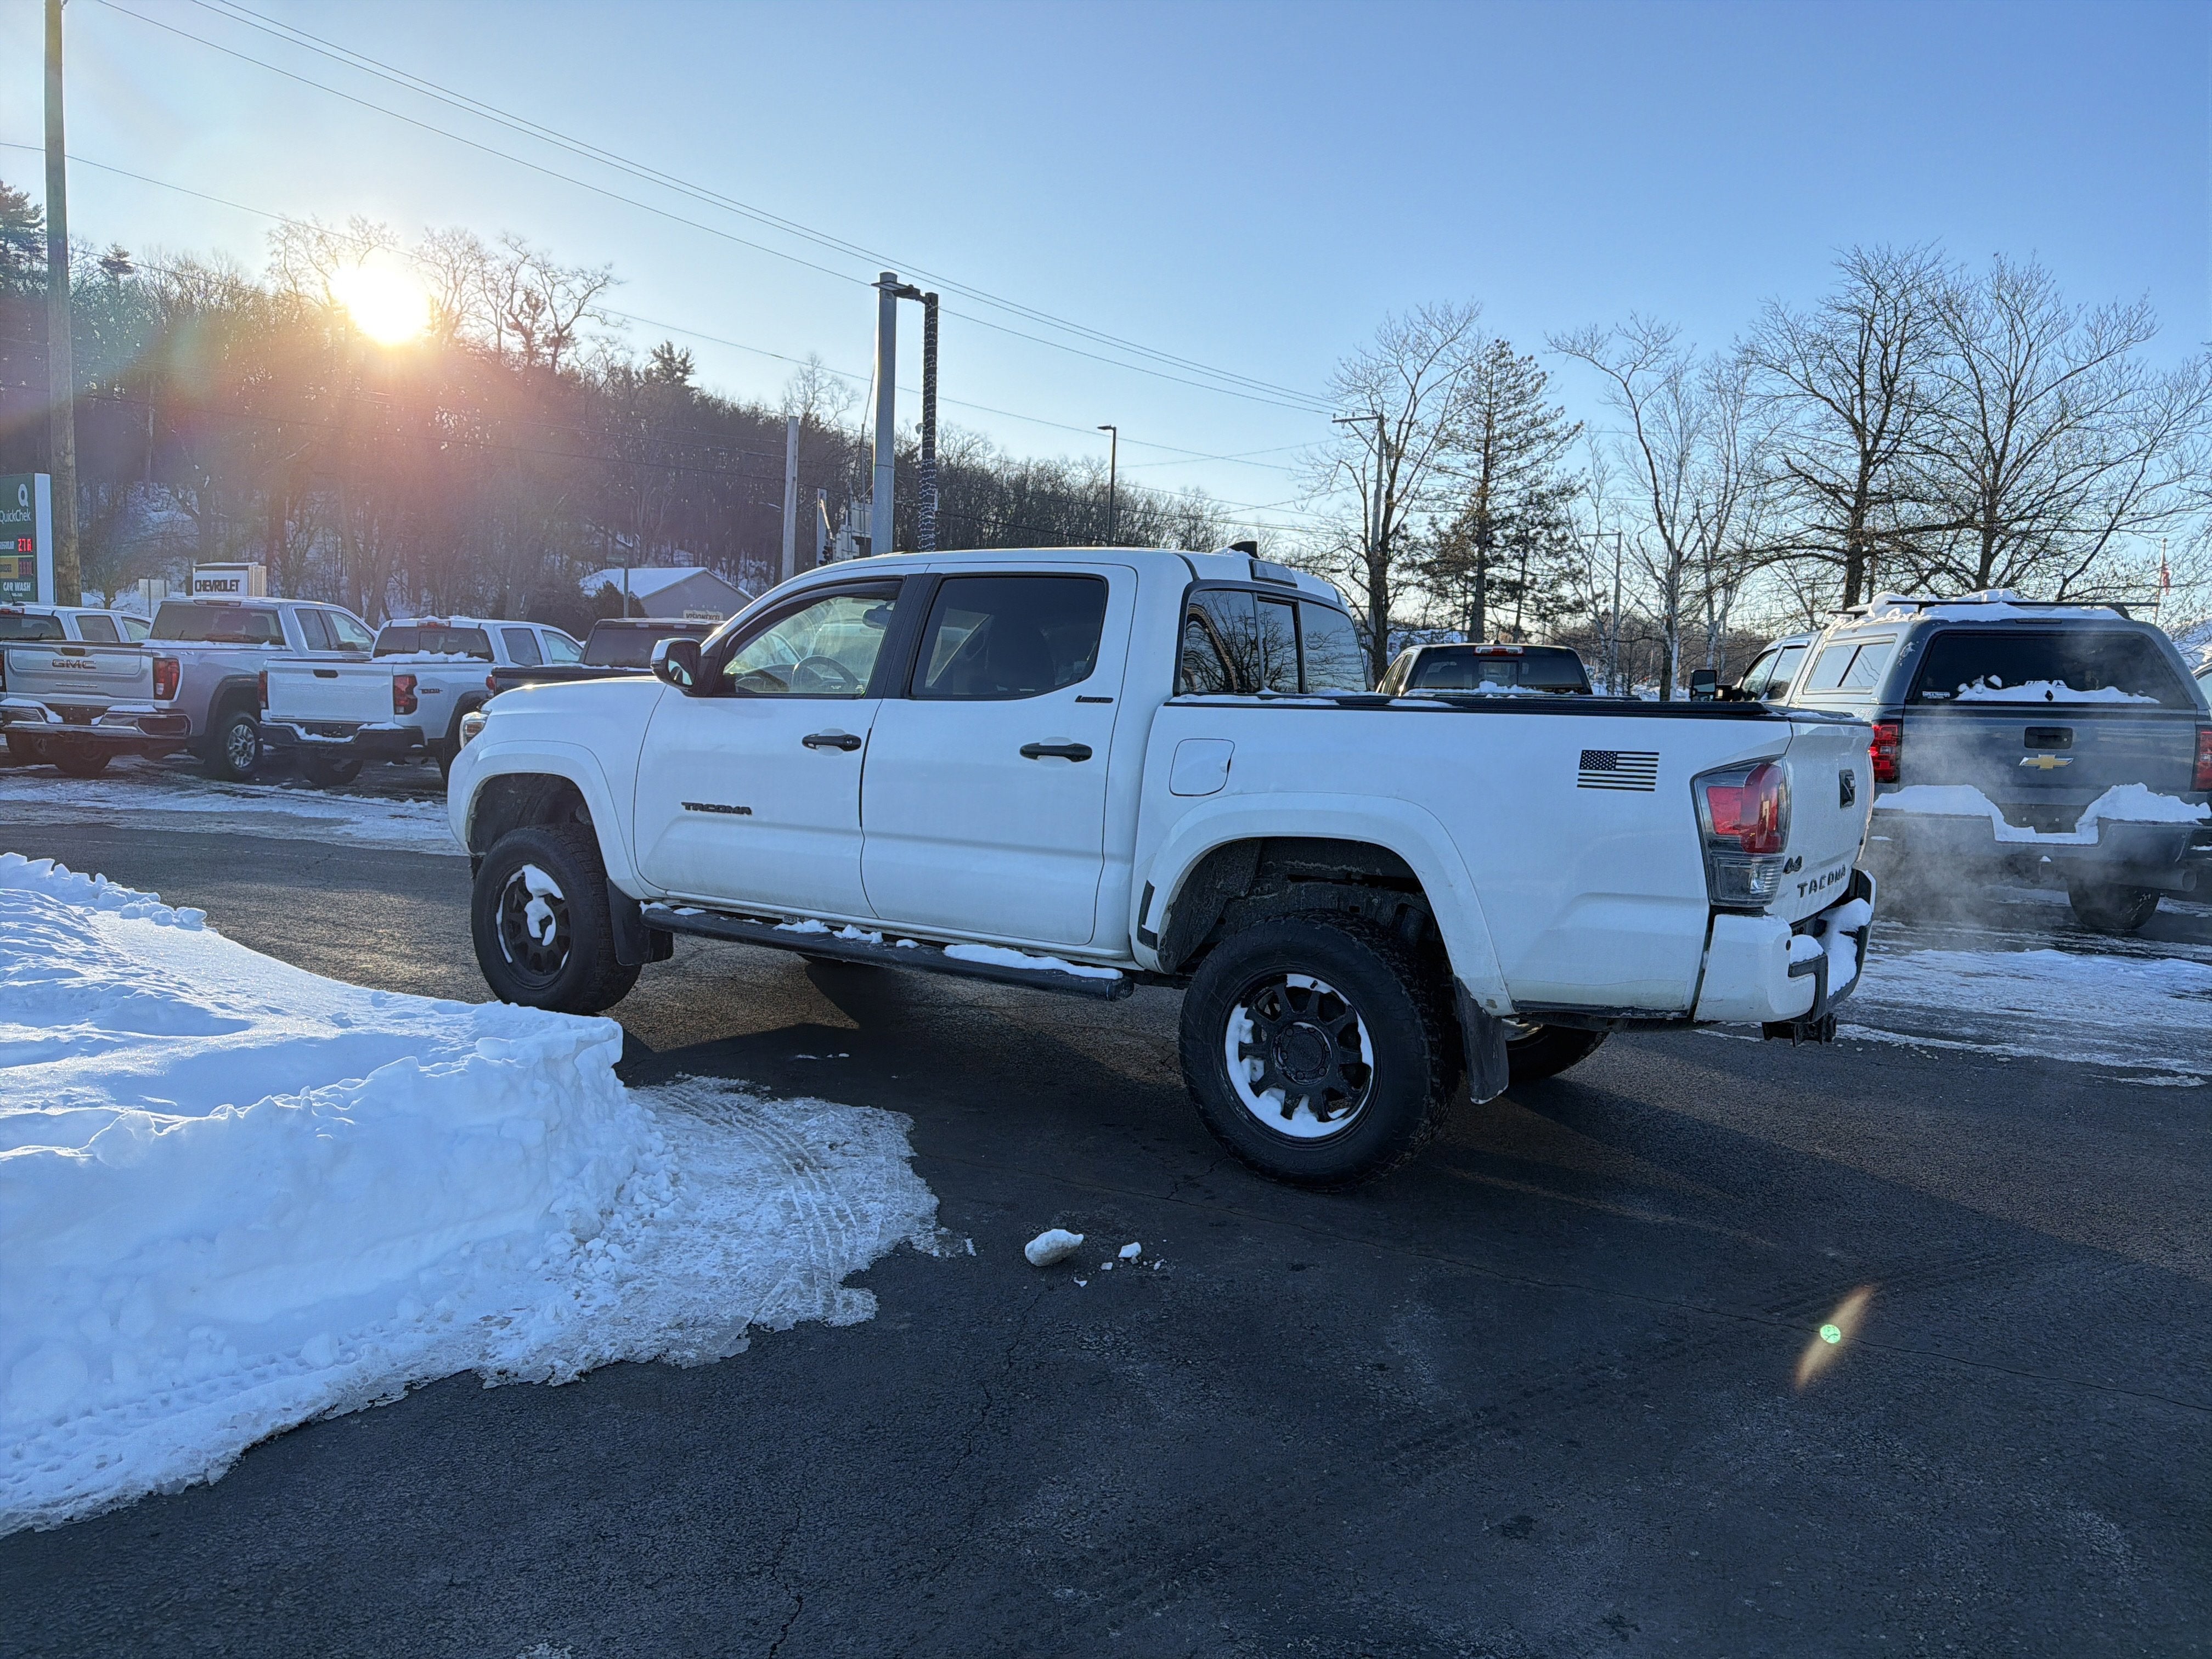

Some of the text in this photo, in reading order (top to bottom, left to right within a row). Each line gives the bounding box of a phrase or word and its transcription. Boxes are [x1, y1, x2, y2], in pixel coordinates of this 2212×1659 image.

[18, 483, 29, 507] Q
[0, 508, 31, 524] QuickChek
[3, 582, 31, 591] CAR WASH
[194, 579, 240, 592] CHEVROLET
[52, 659, 97, 669] GMC
[681, 802, 752, 815] TACOMA
[1797, 864, 1846, 898] TACOMA
